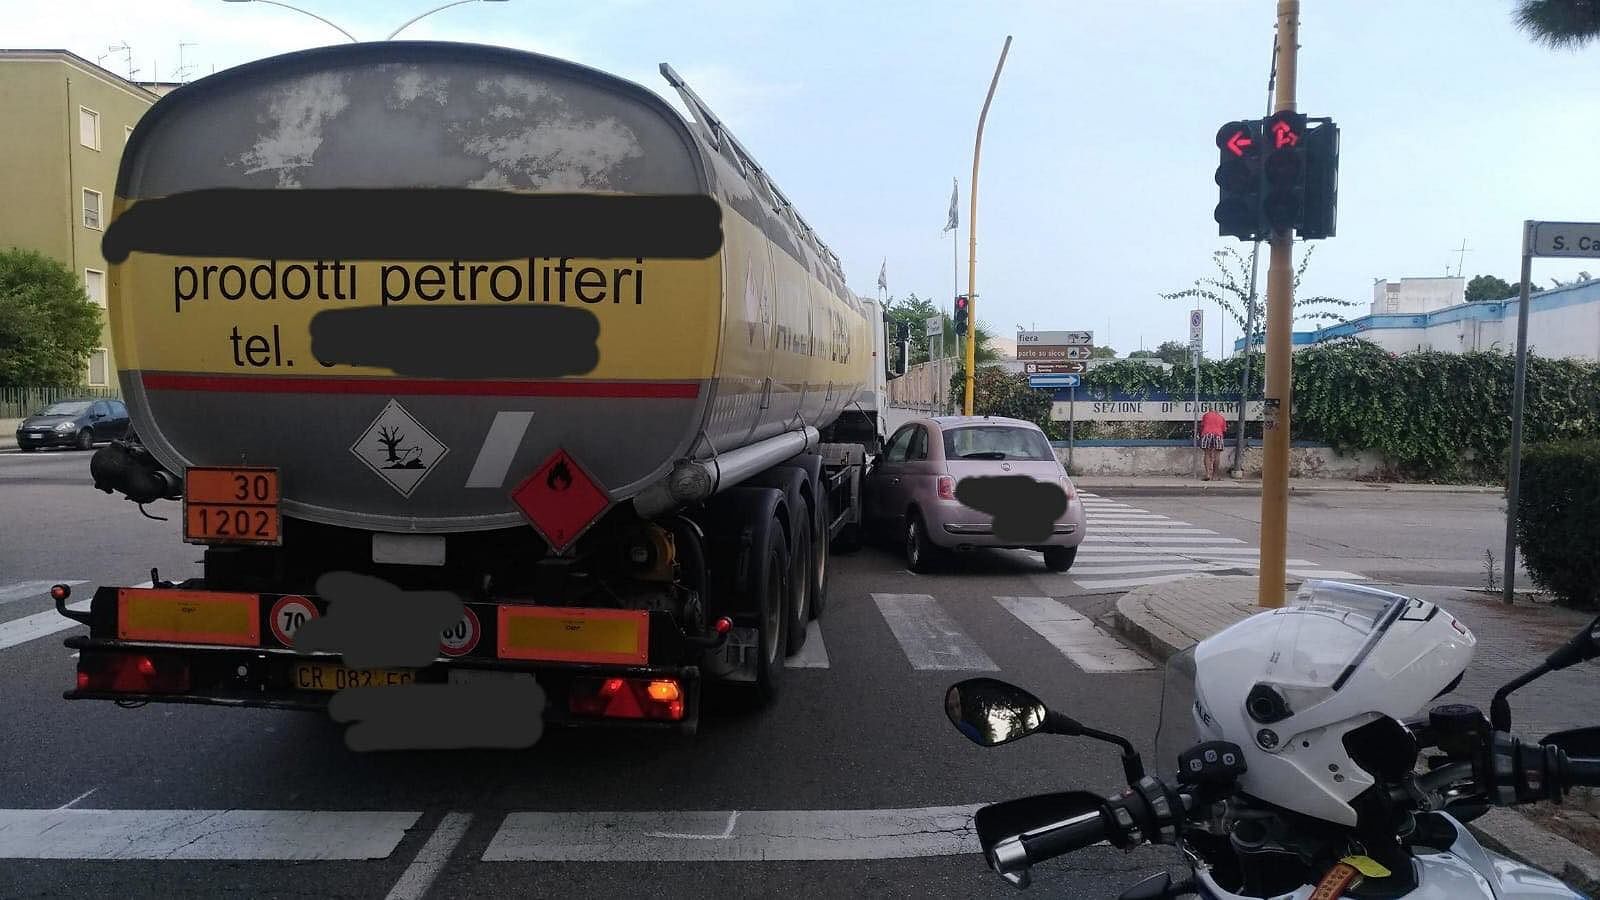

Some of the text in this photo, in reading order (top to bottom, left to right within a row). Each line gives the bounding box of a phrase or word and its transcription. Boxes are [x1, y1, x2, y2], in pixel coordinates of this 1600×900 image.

[1553, 235, 1570, 251] S.
[173, 255, 644, 313] prodotti petroliferi
[229, 324, 295, 368] tel.
[1019, 334, 1039, 342] fiera
[1094, 402, 1143, 414] SEZIONE
[1161, 402, 1174, 414] DI
[234, 474, 269, 501] 30
[199, 508, 270, 537] 1202
[298, 666, 323, 689] CR
[335, 668, 373, 690] 082
